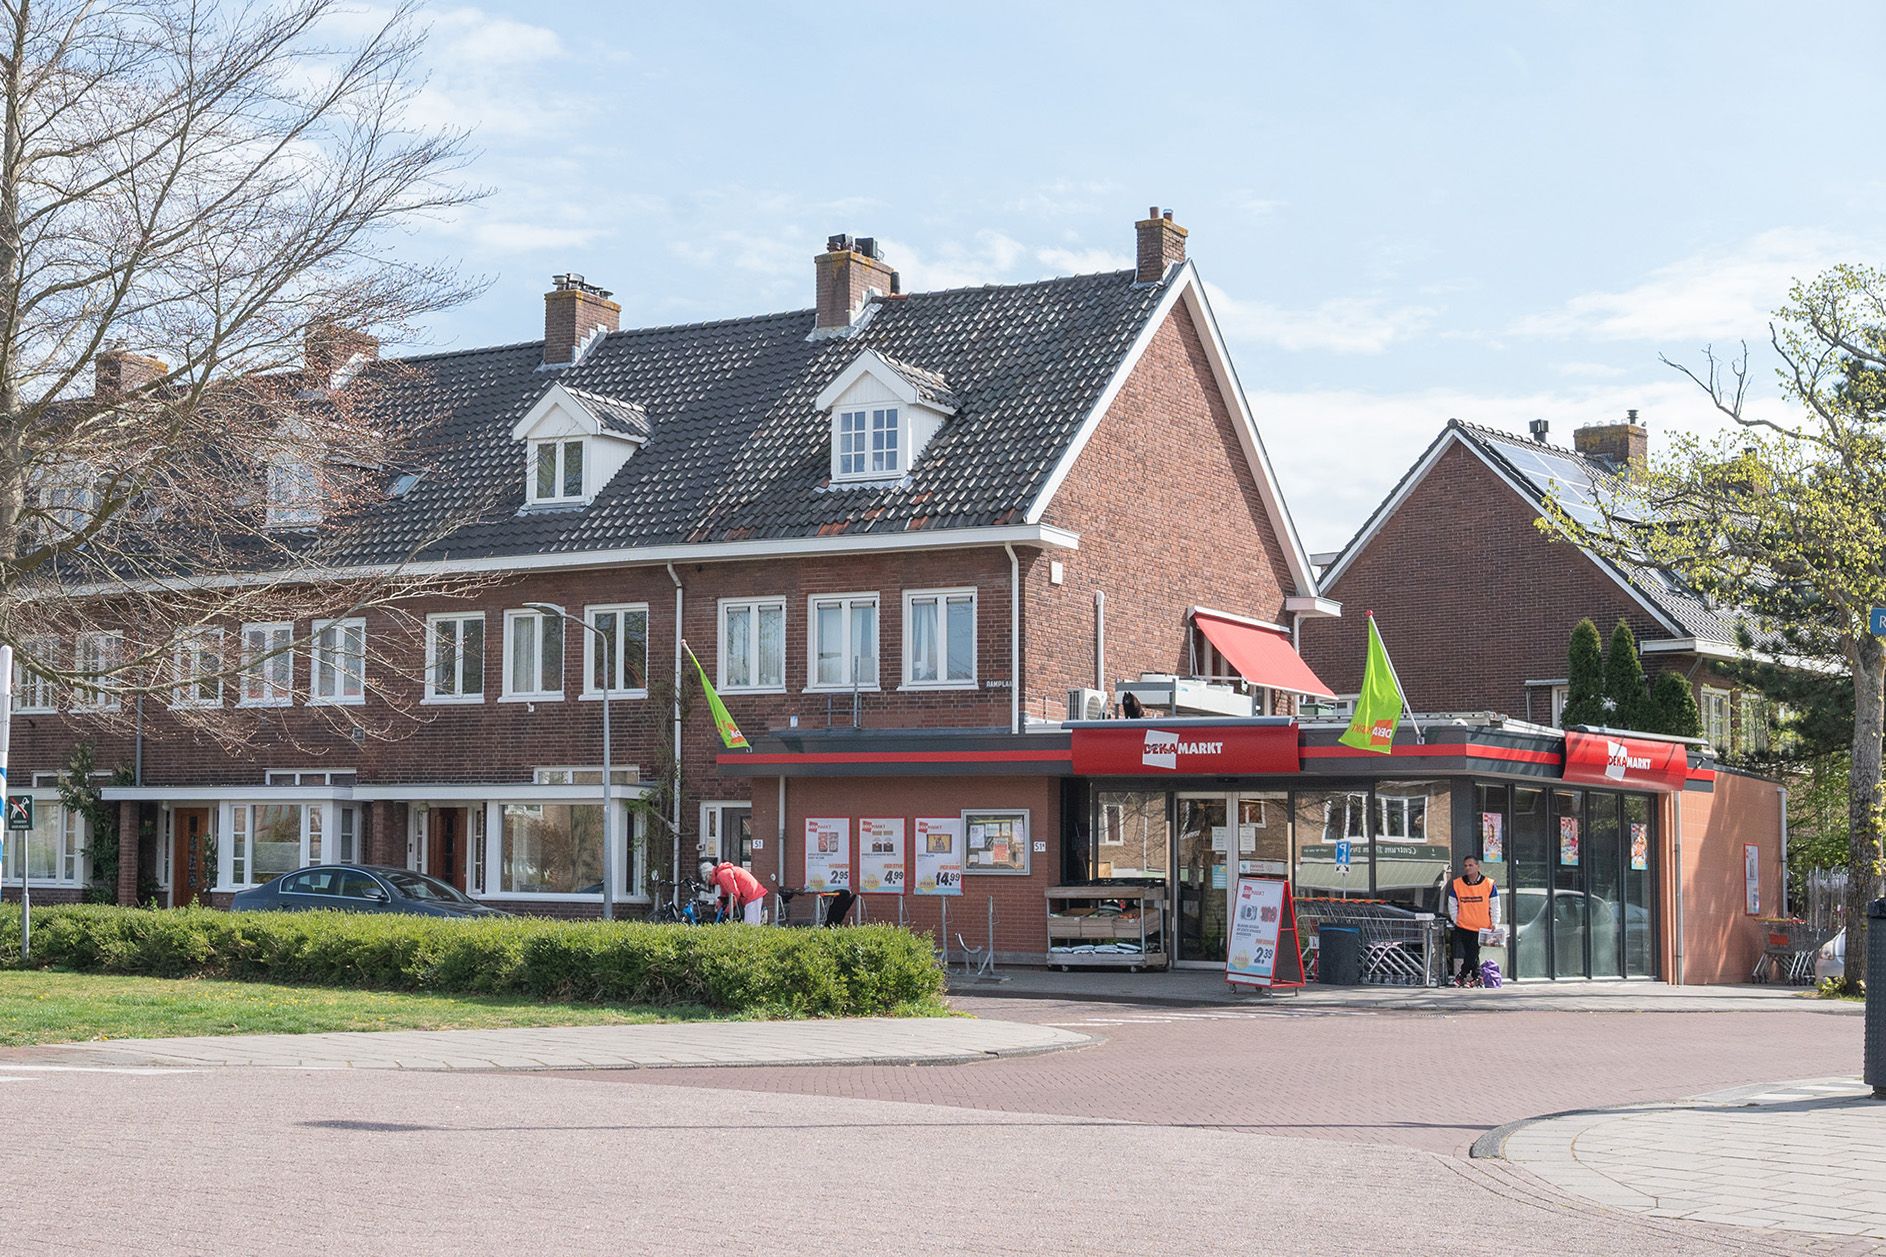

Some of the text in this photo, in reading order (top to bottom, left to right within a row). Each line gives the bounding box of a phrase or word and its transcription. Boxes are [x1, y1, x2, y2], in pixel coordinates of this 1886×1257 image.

[1144, 742, 1223, 755] DEKAMARKT
[1608, 755, 1652, 770] DEKAMARKT
[754, 840, 762, 848] 51
[830, 870, 848, 884] 2.95
[885, 870, 904, 884] 4.99
[936, 872, 960, 886] 14.99
[1254, 946, 1273, 964] 2.39
